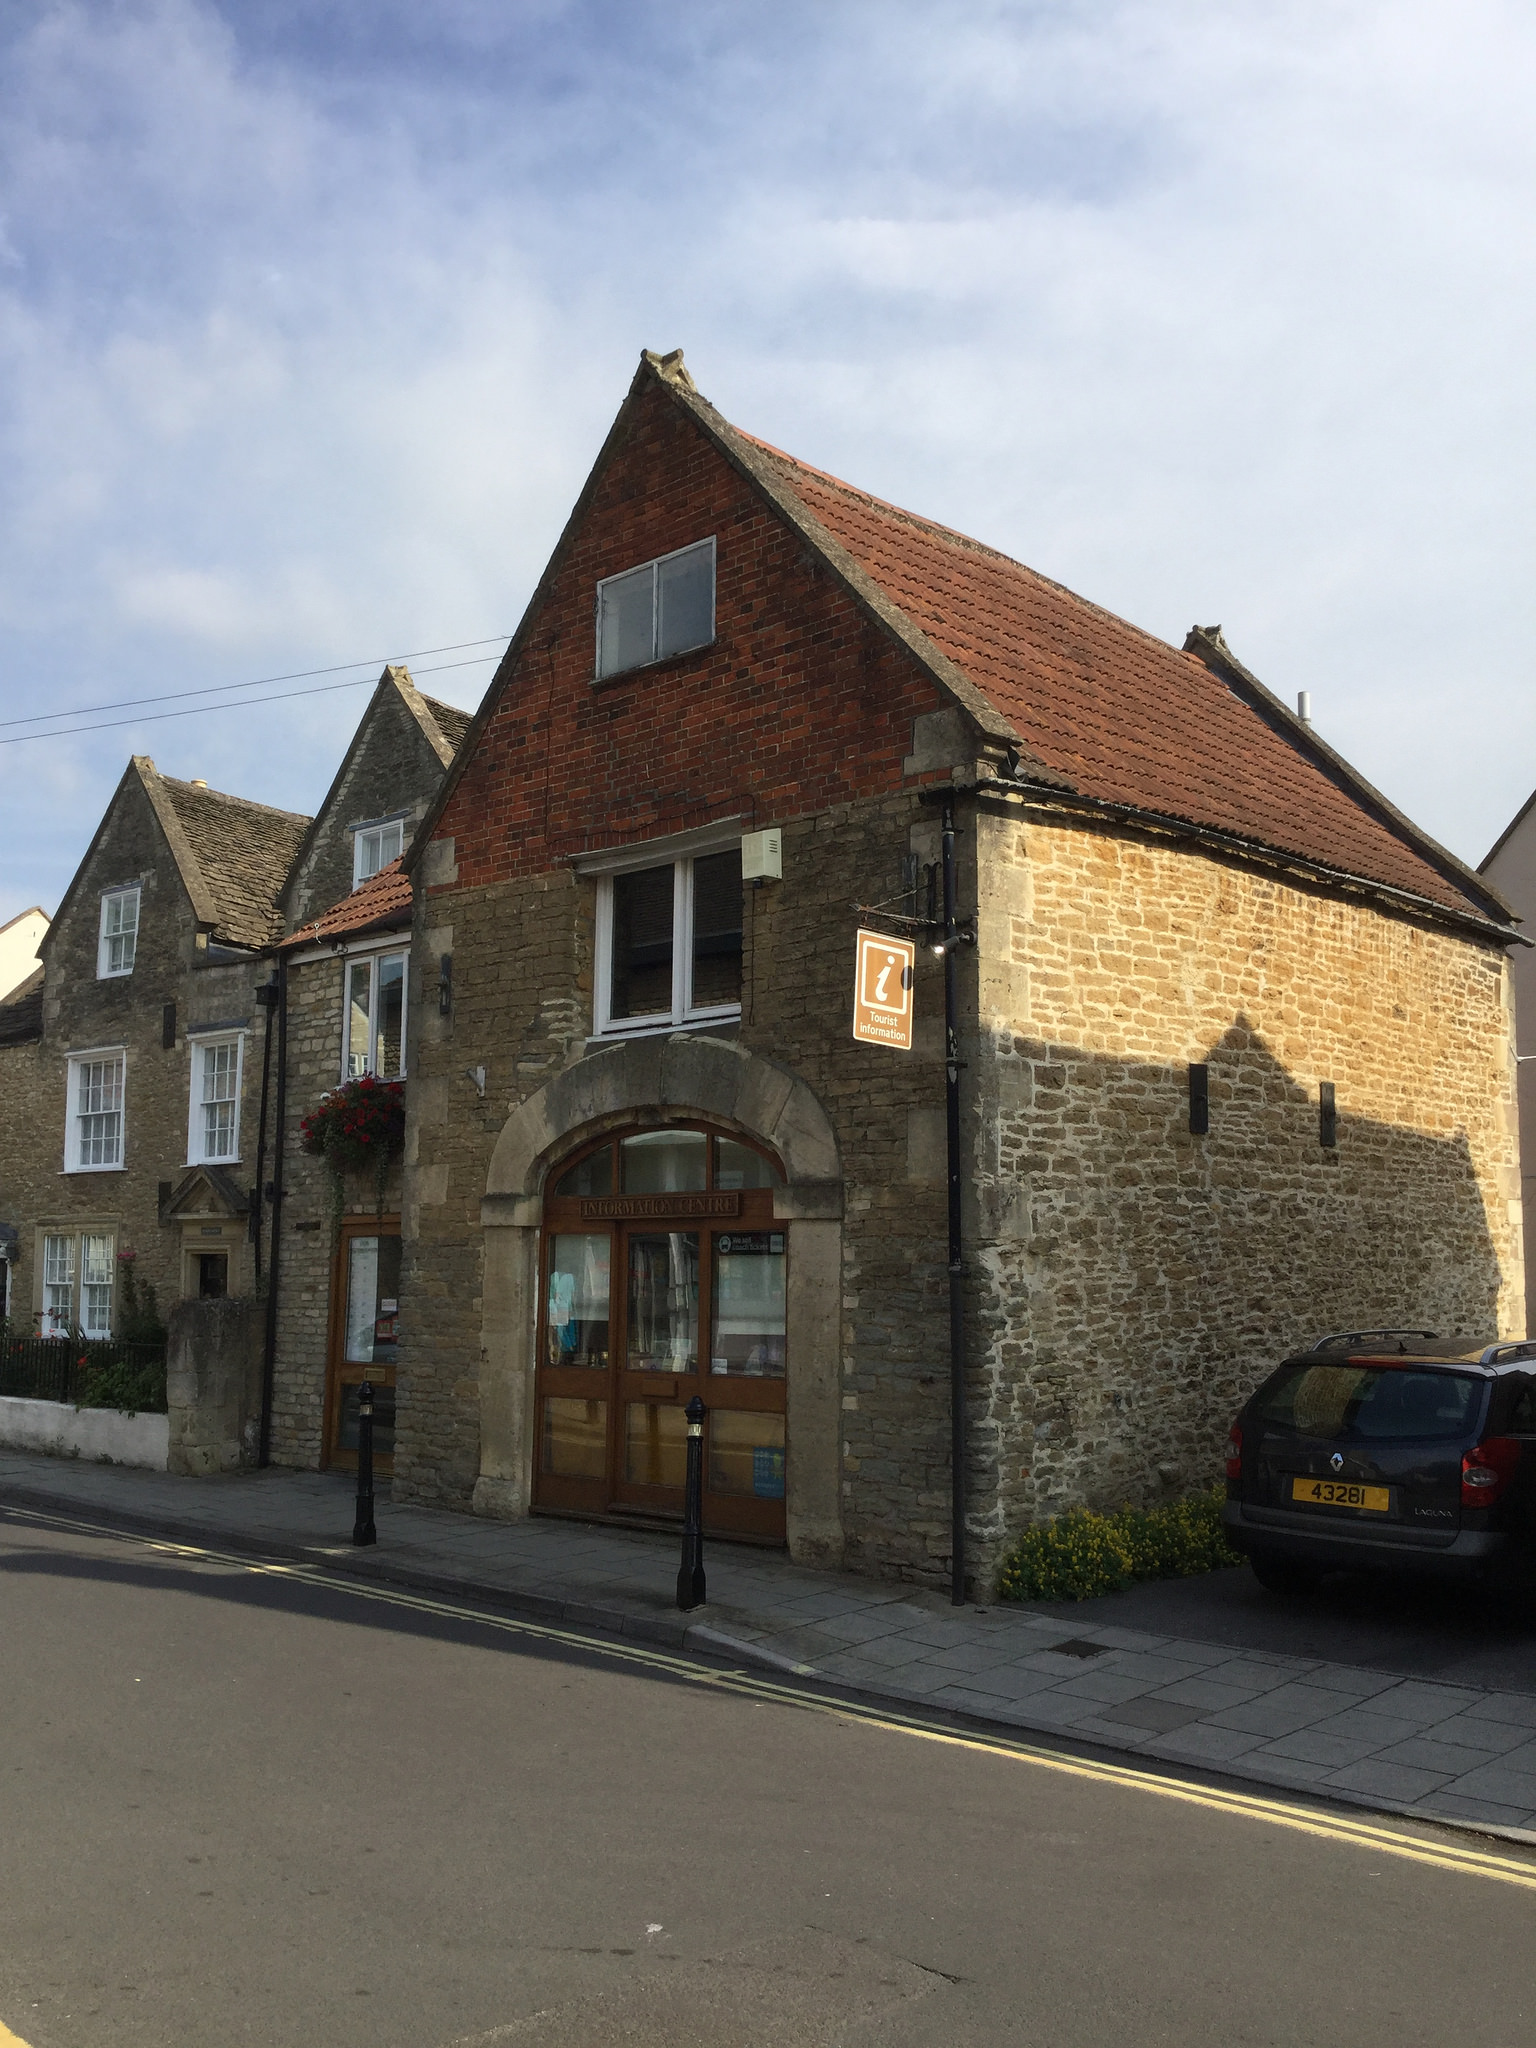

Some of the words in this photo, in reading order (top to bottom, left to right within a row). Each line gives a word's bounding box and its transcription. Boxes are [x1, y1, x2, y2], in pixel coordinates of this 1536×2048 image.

[869, 1011, 898, 1027] Tourist
[859, 1022, 906, 1041] information
[582, 1198, 674, 1217] INFORMATION
[681, 1196, 734, 1214] CENTRE
[1311, 1483, 1365, 1505] 43281
[1414, 1506, 1453, 1518] LAGUNA
